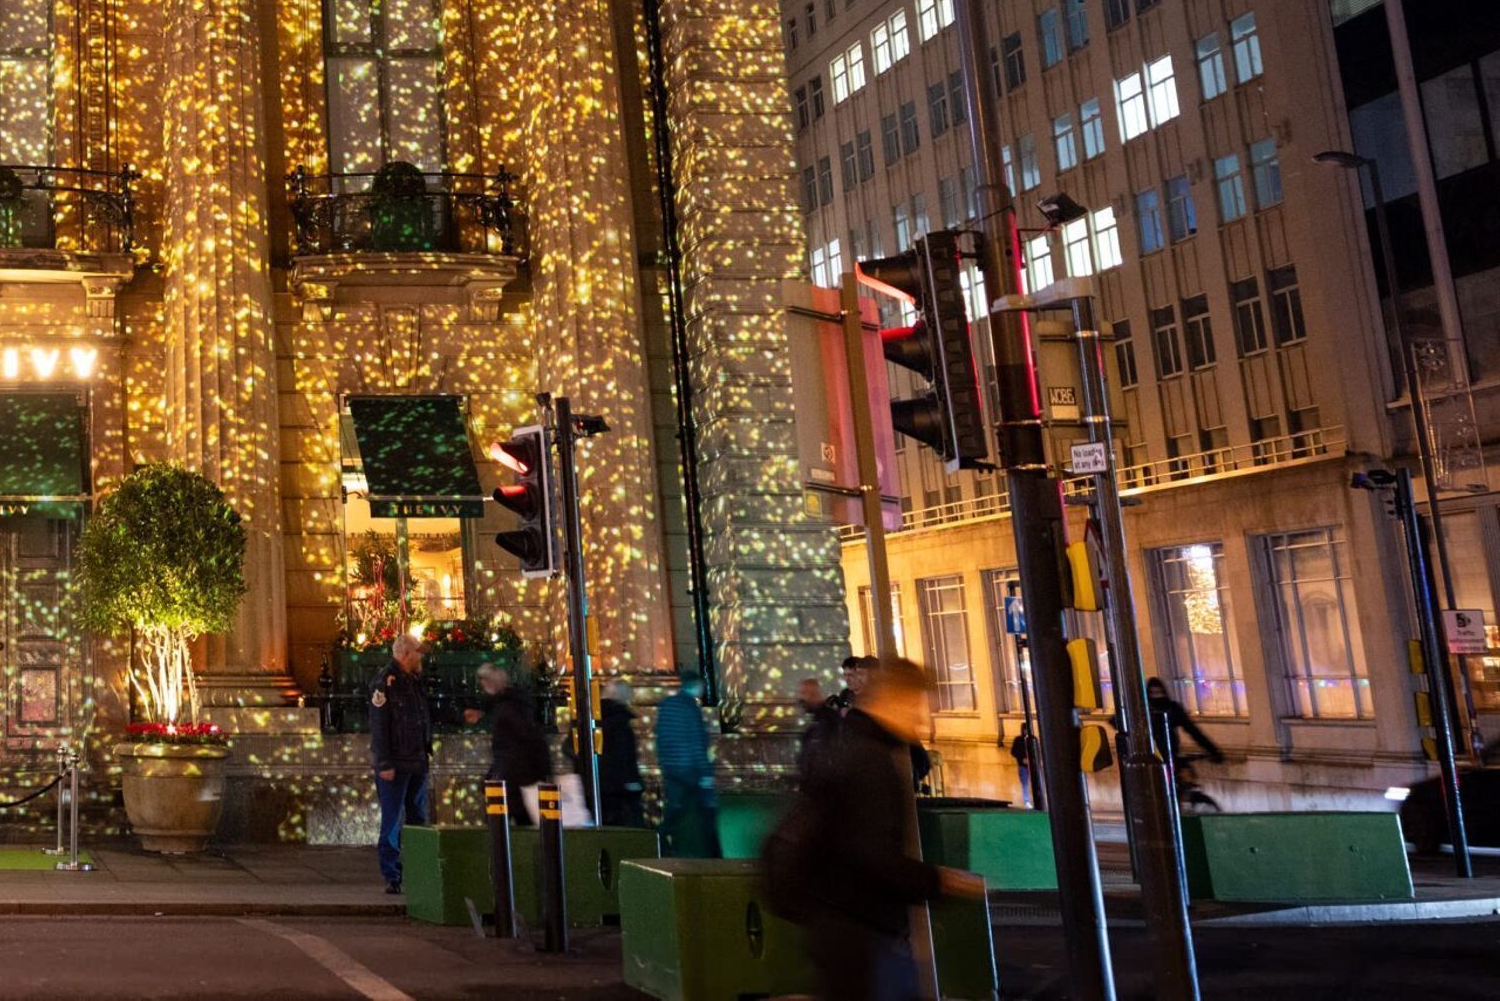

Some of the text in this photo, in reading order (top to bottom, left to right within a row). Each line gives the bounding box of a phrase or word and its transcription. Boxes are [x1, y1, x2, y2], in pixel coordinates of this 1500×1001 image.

[3, 347, 97, 379] IVY
[0, 505, 30, 515] IVY
[431, 505, 462, 514] IVY
